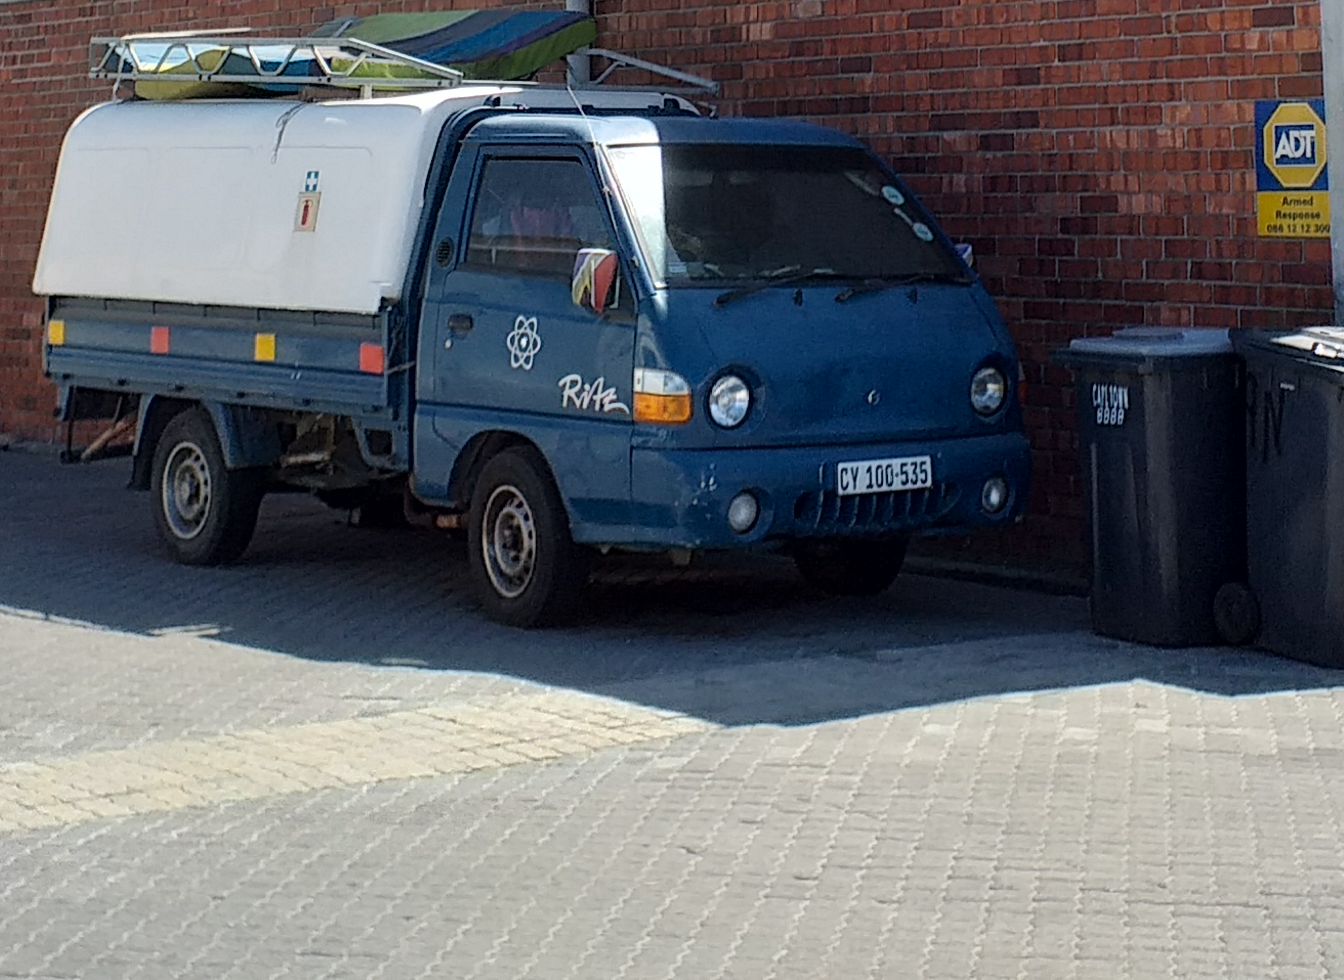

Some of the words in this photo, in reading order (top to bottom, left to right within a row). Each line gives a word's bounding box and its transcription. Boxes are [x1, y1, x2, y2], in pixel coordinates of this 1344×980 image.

[1274, 129, 1316, 159] ADT
[1282, 196, 1314, 207] Armed
[1275, 211, 1321, 222] Response
[1287, 224, 1297, 233] 12
[1301, 224, 1312, 233] 12
[558, 373, 630, 415] Ritz
[840, 467, 859, 491] CY
